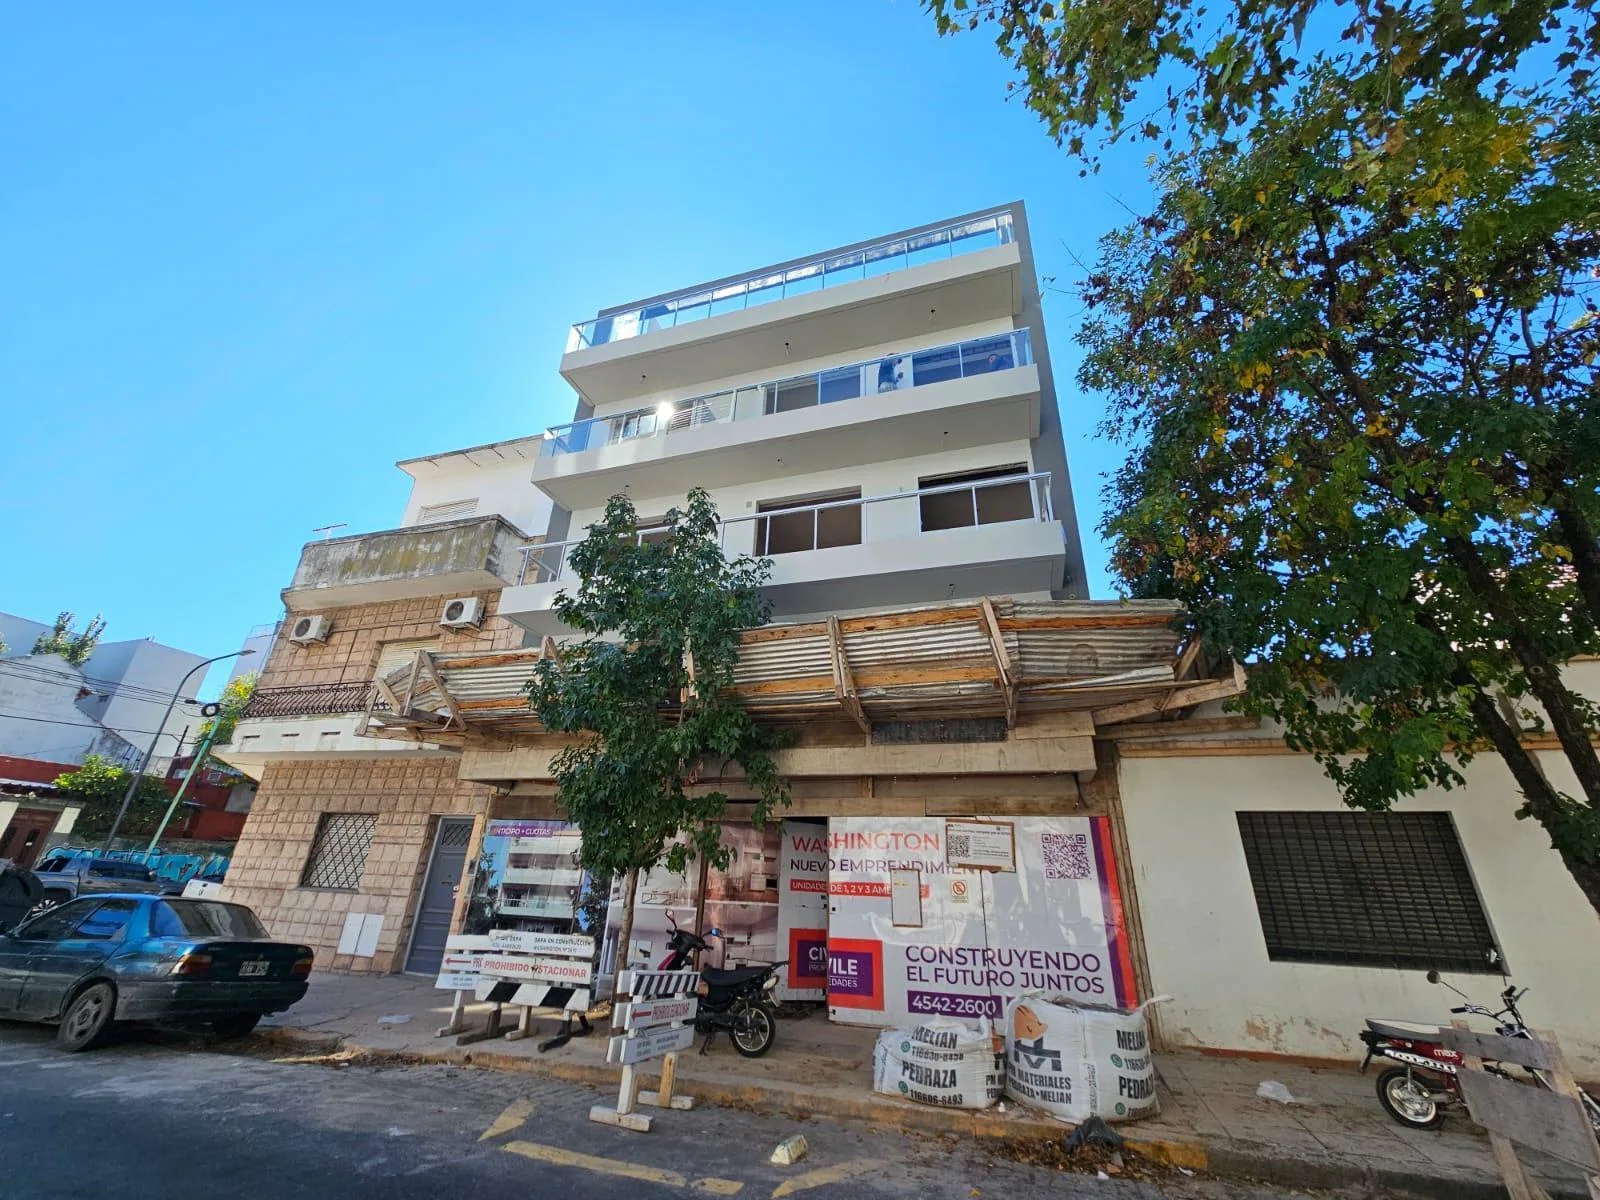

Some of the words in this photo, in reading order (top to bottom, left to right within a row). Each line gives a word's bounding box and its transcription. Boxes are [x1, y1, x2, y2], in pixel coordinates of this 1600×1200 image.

[524, 828, 552, 836] CUOTAS
[791, 831, 940, 853] WASHINGTON
[790, 858, 835, 872] NUEVO
[792, 881, 827, 890] UNIDADE
[851, 885, 857, 893] 2
[858, 885, 864, 893] Y
[865, 885, 871, 893] 3
[484, 961, 530, 972] PROHIBIDO
[905, 945, 1101, 973] CONSTRUYENDO
[906, 965, 929, 983] EL
[934, 967, 1015, 987] FUTURO
[1020, 972, 1105, 994] JUNTOS
[912, 995, 996, 1015] 4542-2600
[911, 1025, 958, 1049] MELIAN
[902, 1060, 958, 1088] PEDRAZA
[1017, 1070, 1072, 1090] MATERIALES
